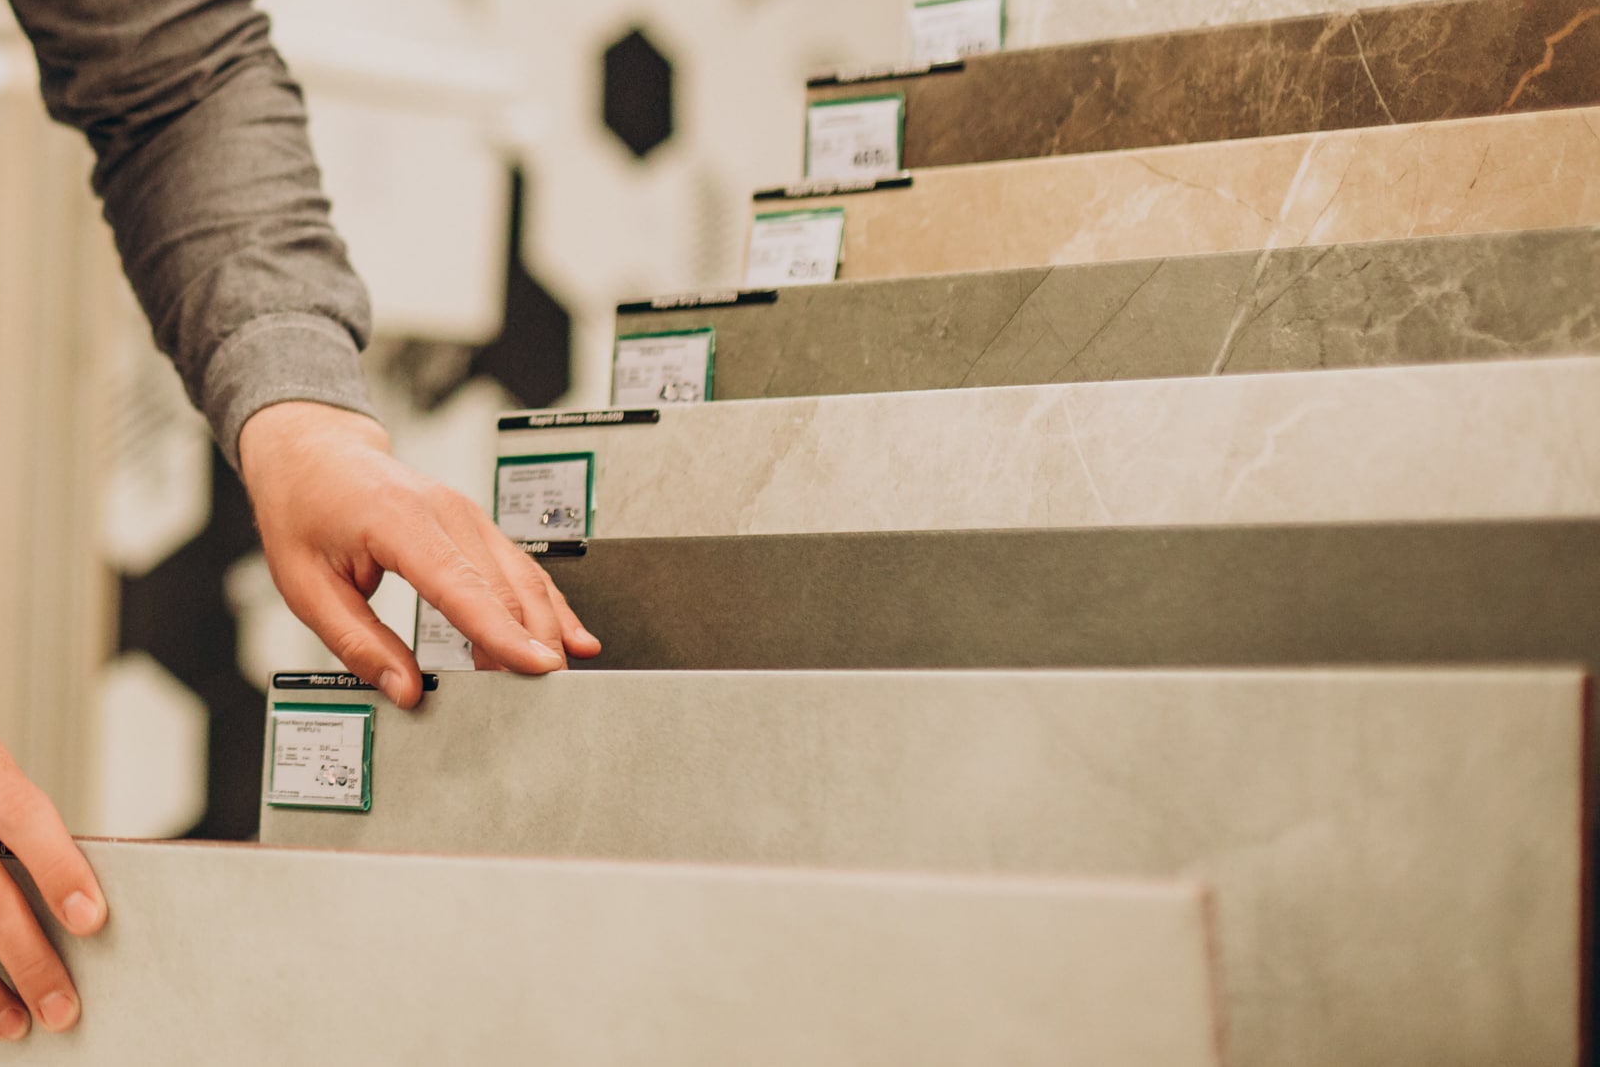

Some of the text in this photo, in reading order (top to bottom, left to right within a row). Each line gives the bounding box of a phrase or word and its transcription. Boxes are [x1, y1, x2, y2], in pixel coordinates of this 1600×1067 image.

[586, 411, 624, 423] 600x600
[310, 675, 336, 685] Macro
[337, 675, 357, 687] Grys
